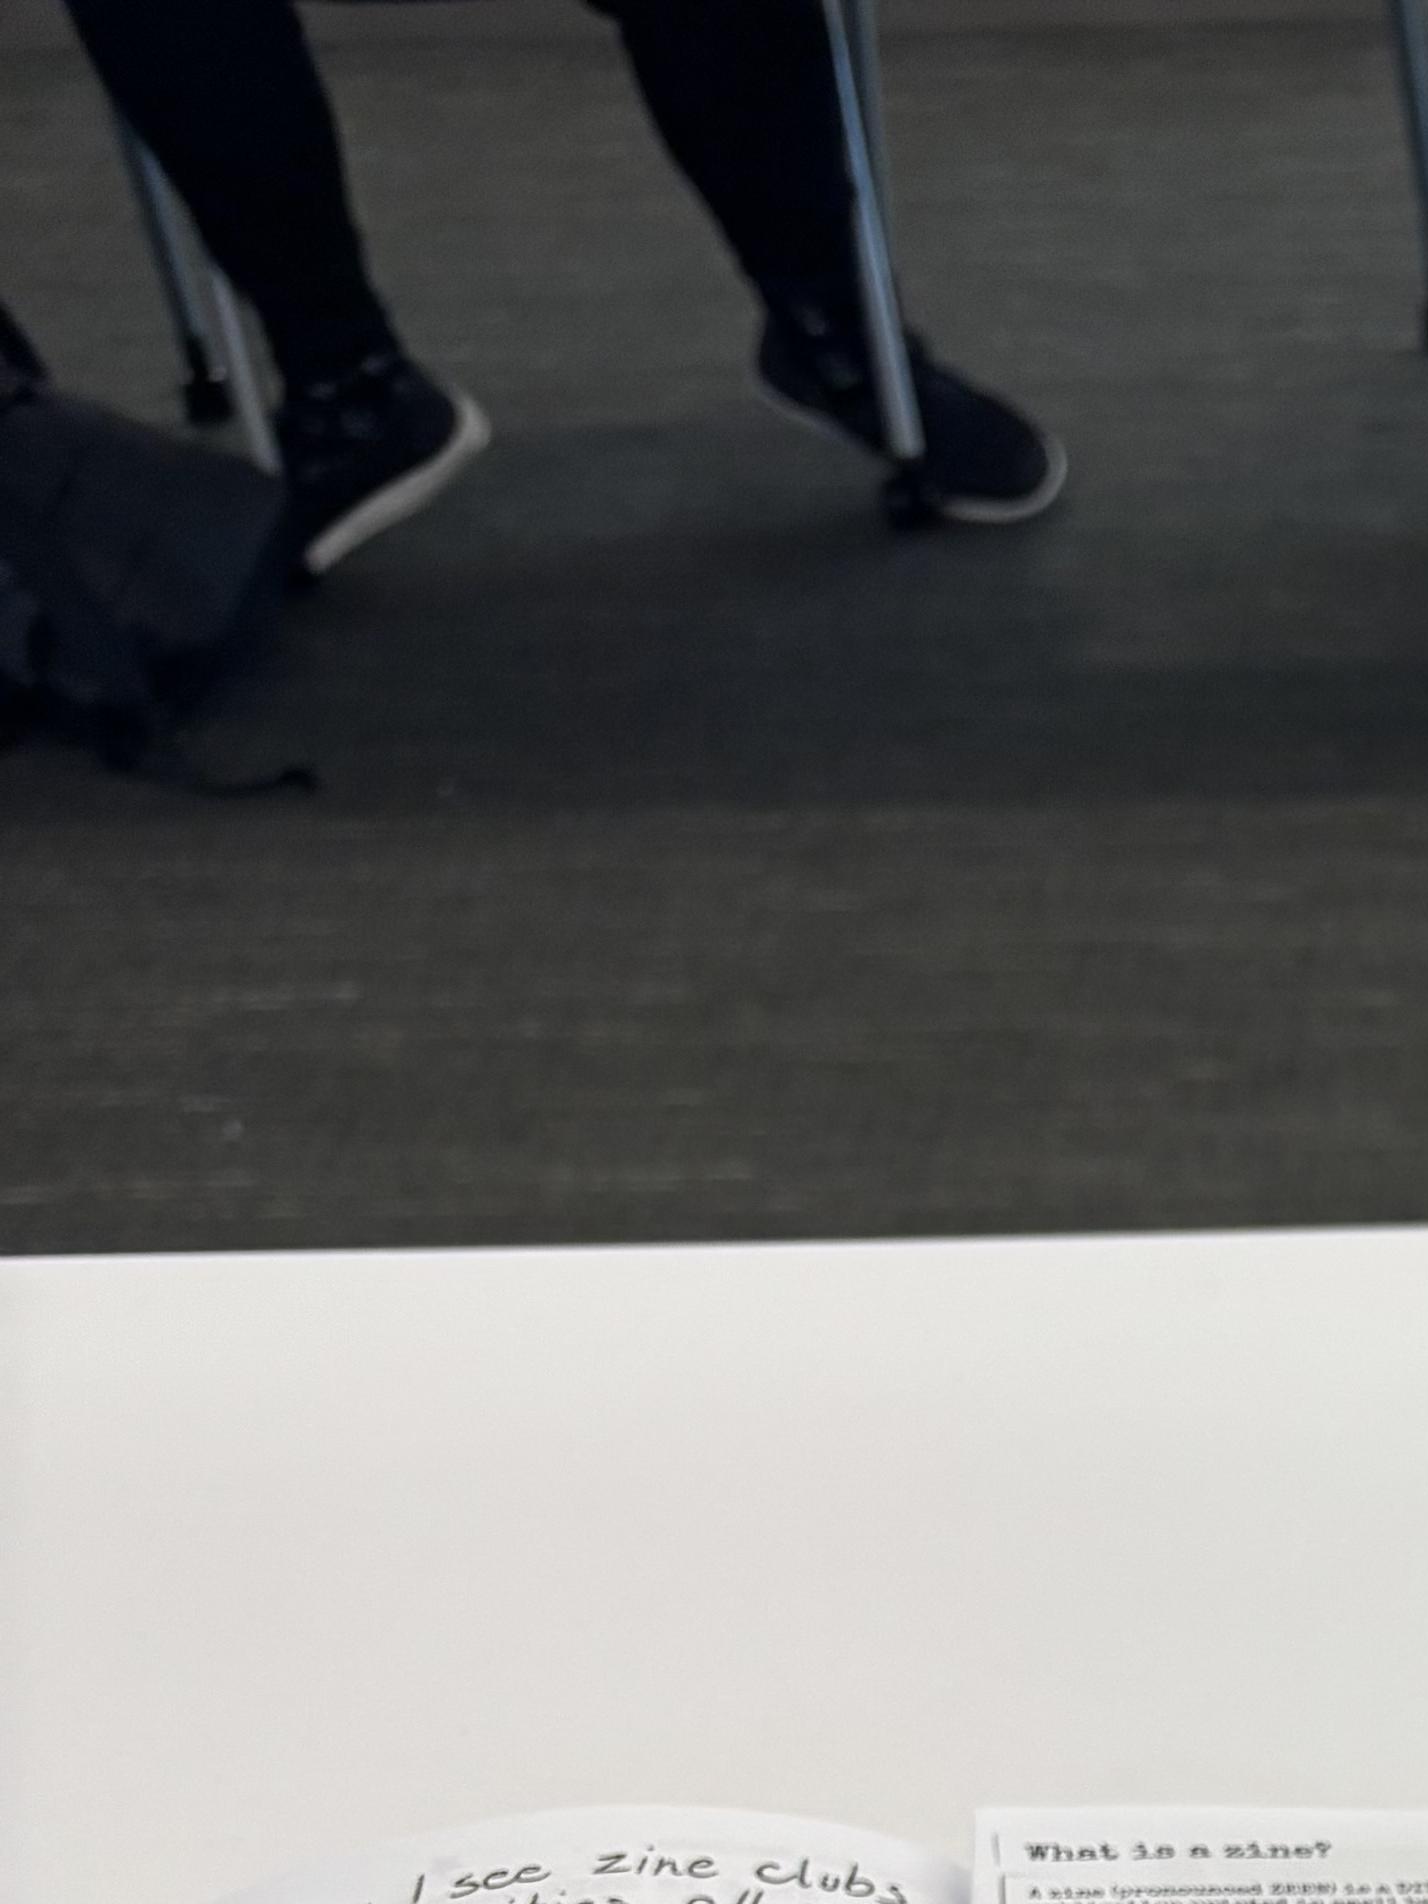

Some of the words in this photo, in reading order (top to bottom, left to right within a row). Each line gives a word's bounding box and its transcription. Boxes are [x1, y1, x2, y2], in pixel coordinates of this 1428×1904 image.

[1025, 1841, 1119, 1862] What
[1132, 1842, 1176, 1861] is
[1188, 1844, 1212, 1860] a
[1222, 1840, 1332, 1859] zine?
[411, 1874, 425, 1904] I
[449, 1864, 551, 1904] see
[592, 1845, 718, 1879] zine
